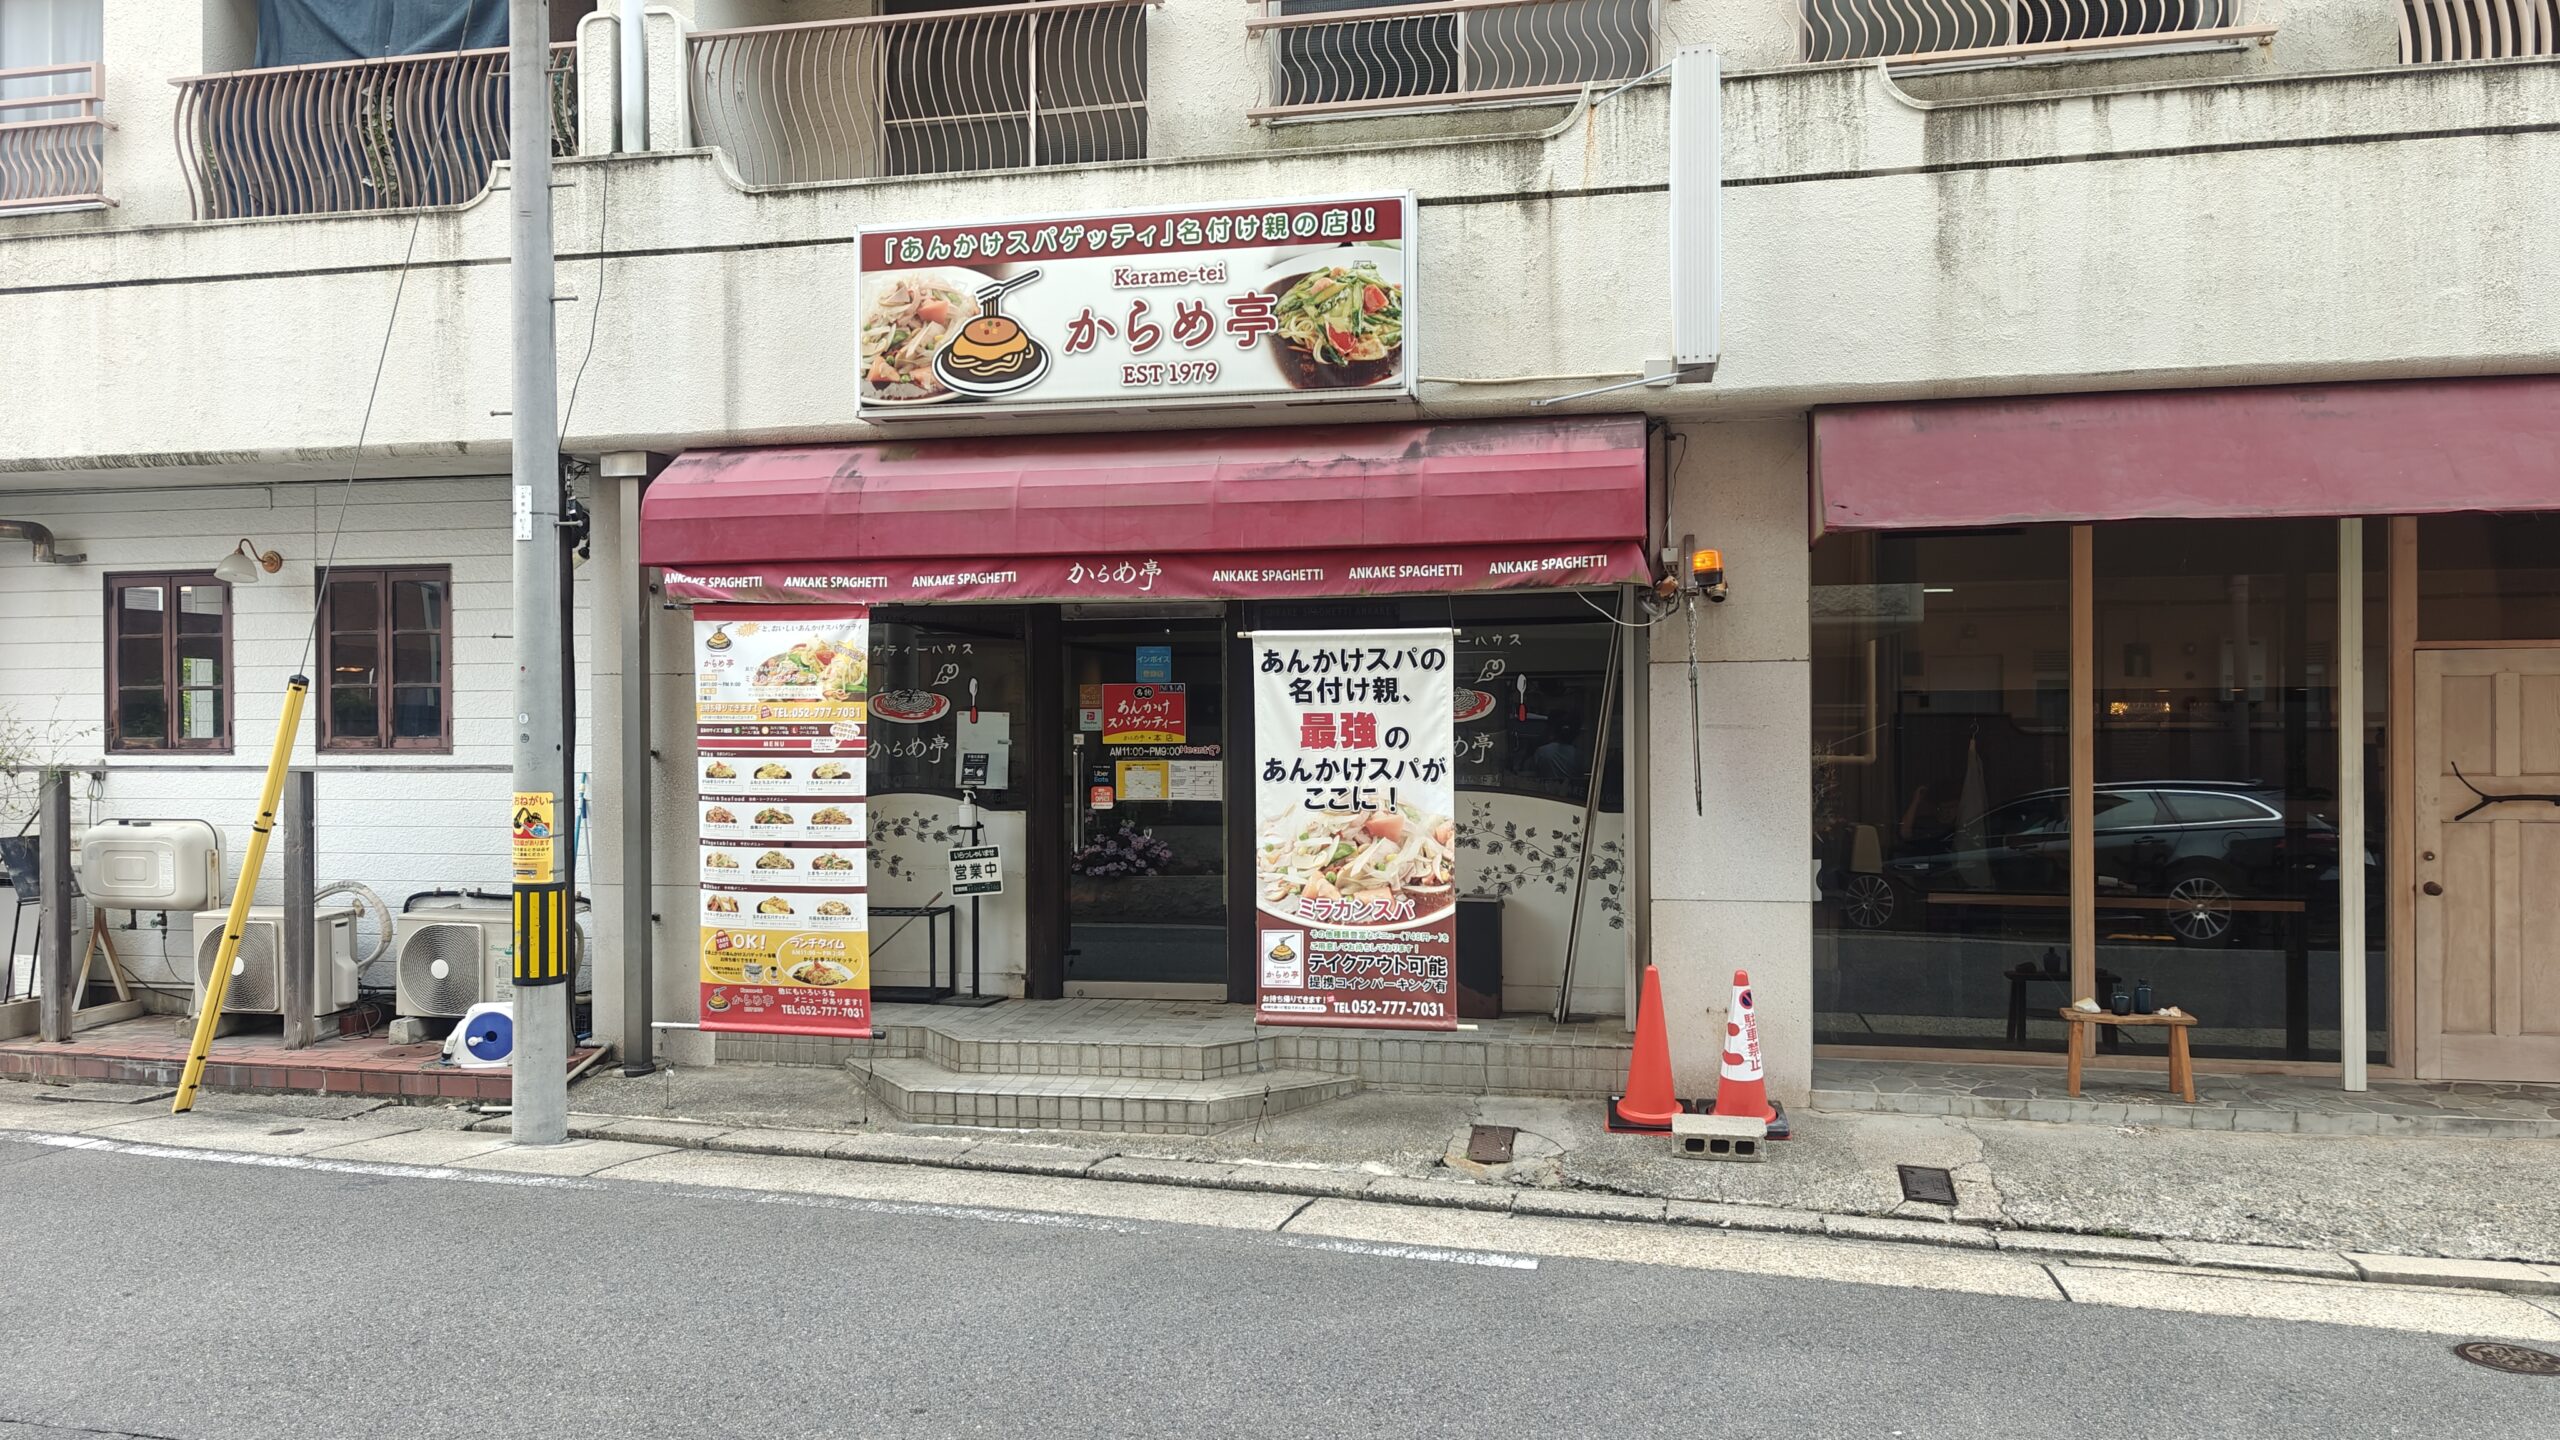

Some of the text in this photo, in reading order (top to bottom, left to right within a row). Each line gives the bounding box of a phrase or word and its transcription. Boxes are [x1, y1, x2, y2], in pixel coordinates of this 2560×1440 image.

[1113, 262, 1227, 289] Karame-tei
[1064, 290, 1280, 356] からめ亭
[1121, 360, 1219, 386] EST 1979
[1349, 564, 1463, 580] ANKAKE SPAGHETTI
[1489, 554, 1608, 575] ANKAKE SPAGHETTI
[708, 576, 762, 588] SPAGHETTI
[784, 576, 888, 588] ANKAKE SPAGHETTI
[912, 571, 1017, 588] ANKAKE SPAGHETTI
[1066, 558, 1162, 591] からめ亭
[1212, 568, 1324, 582] ANKAKE SPAGHETTI
[1138, 656, 1170, 664] インボイス
[1260, 647, 1446, 674] あんかけスパの
[1288, 676, 1412, 704] 名付け親、
[1117, 699, 1171, 715] あんかけ
[1300, 712, 1410, 750] 最強の
[866, 733, 950, 764] からめ亭
[1262, 757, 1447, 782] あんかけスパが
[954, 849, 995, 859] いらっしゃいませ
[954, 861, 997, 880] 営業中
[1298, 898, 1416, 921] ミラカンスパ
[790, 937, 846, 949] ランチタイム
[1266, 970, 1299, 979] からめ亭
[1308, 954, 1448, 977] テイクアウト可能
[778, 988, 836, 997] 他にもいろいろな
[1333, 1000, 1444, 1016] TEL 052-777-7031
